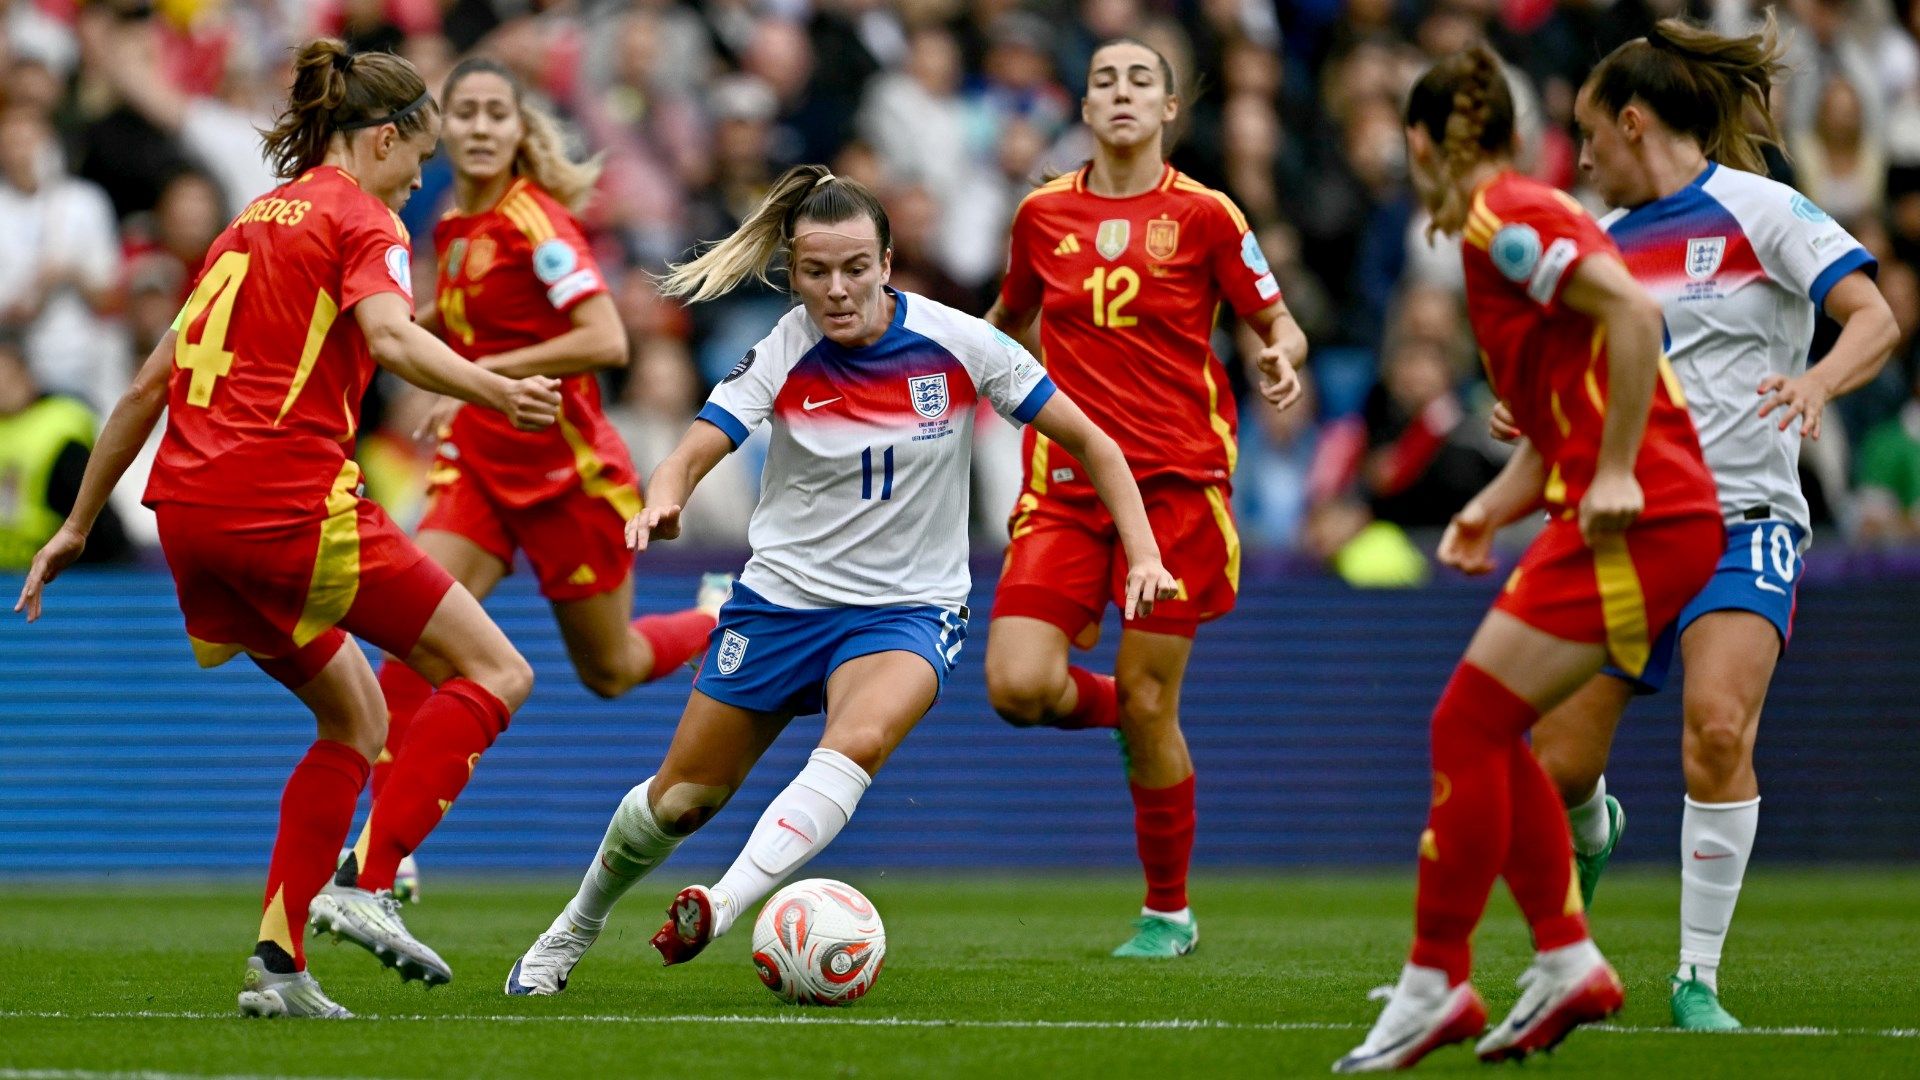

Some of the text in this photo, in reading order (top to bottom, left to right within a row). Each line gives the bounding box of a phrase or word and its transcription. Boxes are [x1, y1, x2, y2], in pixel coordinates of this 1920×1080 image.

[1083, 265, 1141, 328] 12
[175, 250, 250, 409] 4
[861, 445, 894, 500] 11
[1750, 523, 1796, 583] 10
